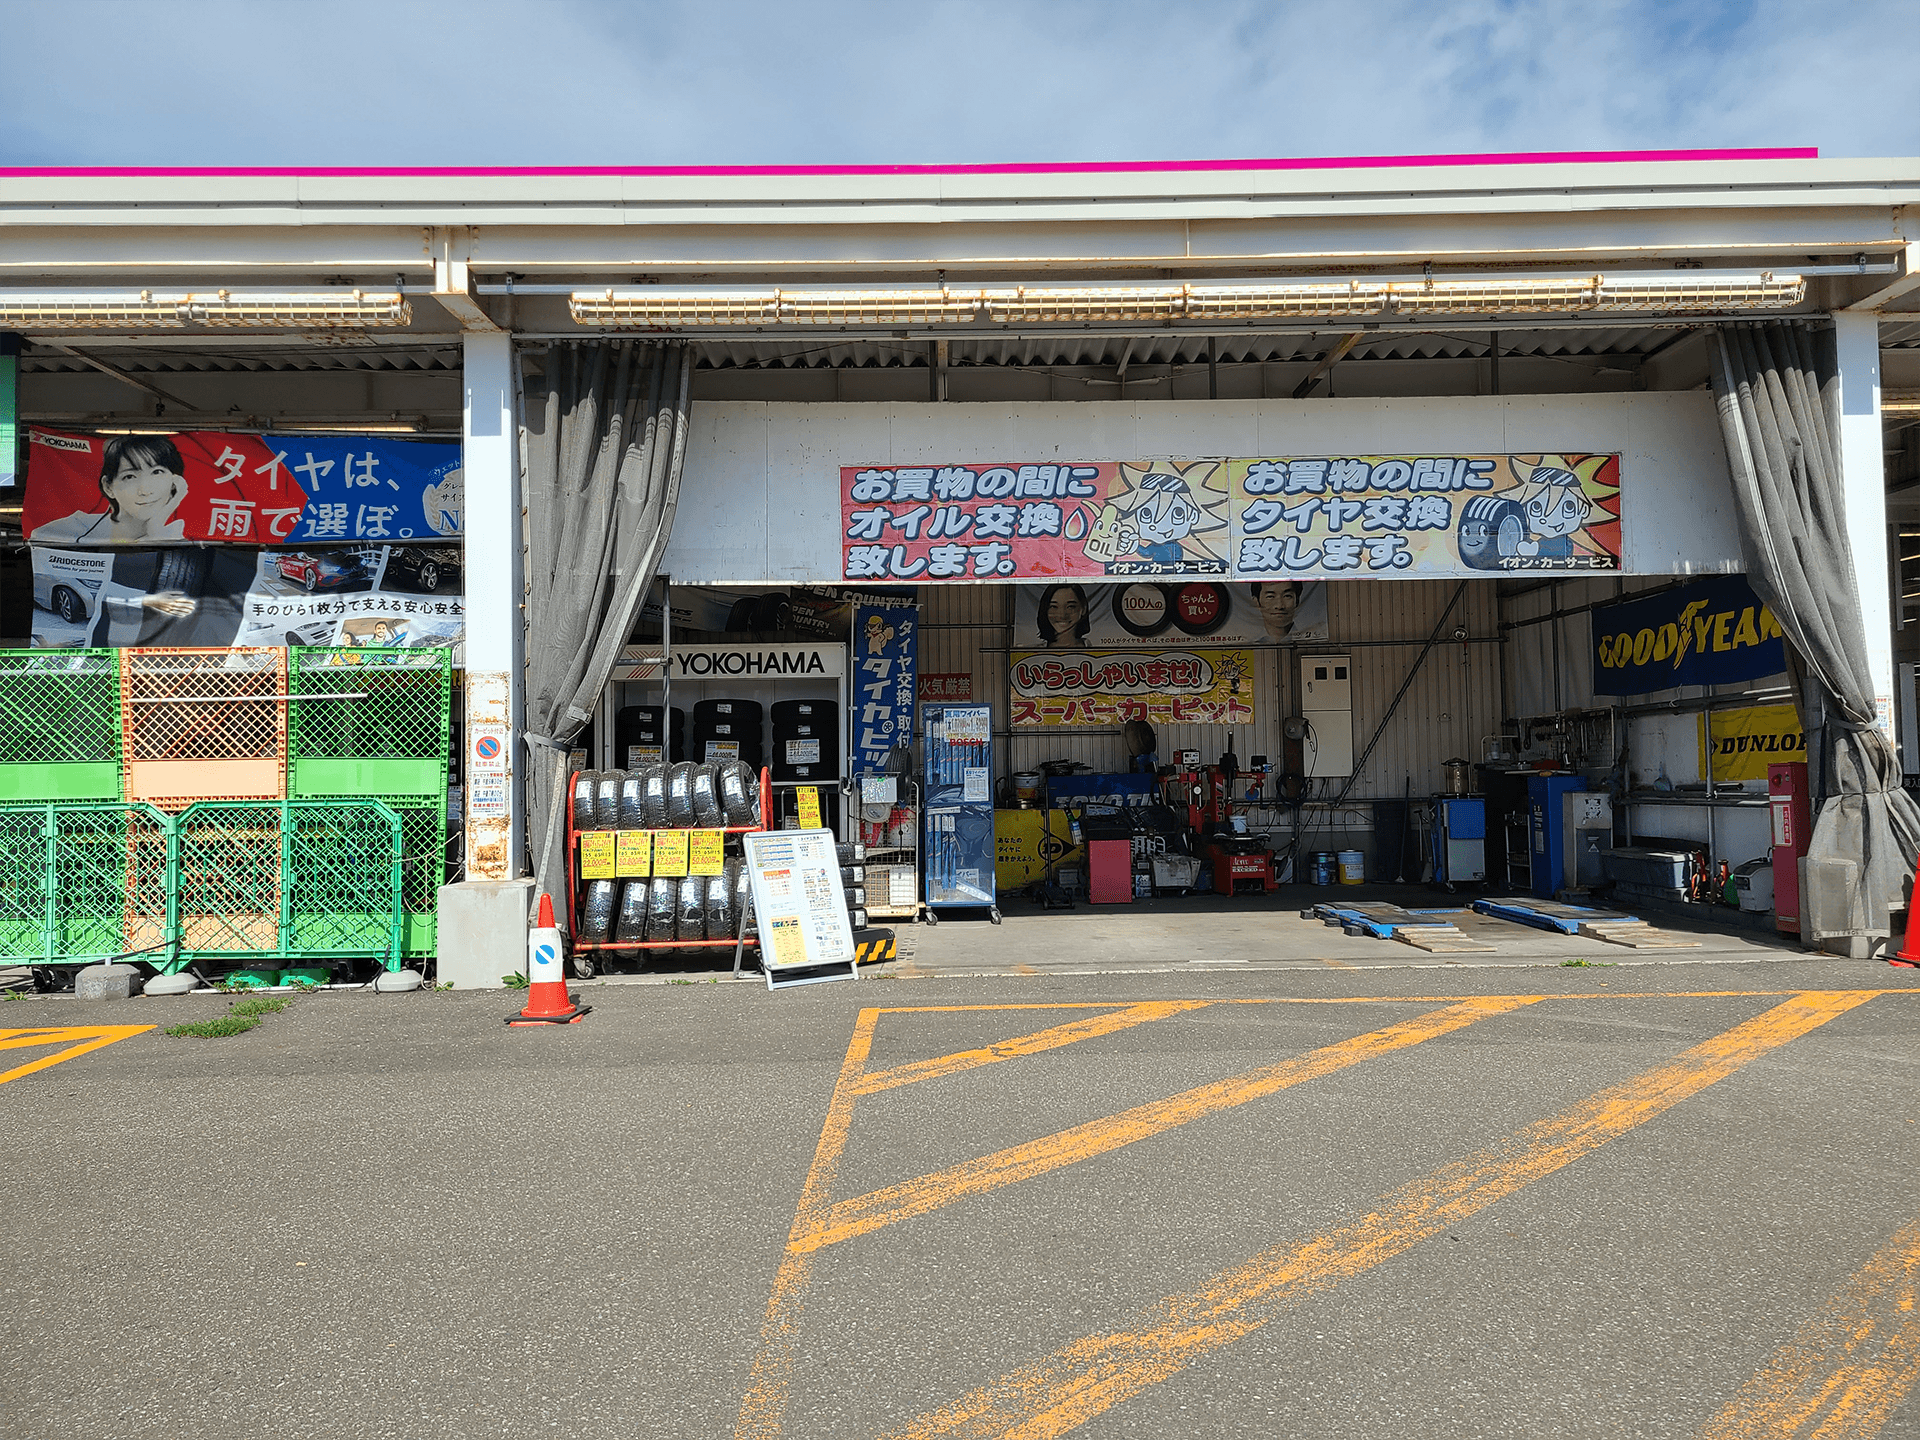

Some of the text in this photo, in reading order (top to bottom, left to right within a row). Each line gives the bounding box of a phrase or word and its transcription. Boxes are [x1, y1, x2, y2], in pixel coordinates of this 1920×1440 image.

[45, 437, 88, 450] YOKOHAMA
[214, 446, 400, 492] タイヤは、
[1243, 458, 1495, 494] お買物の間に
[850, 466, 1098, 502] お買物の間に
[207, 498, 414, 538] 雨で選ぼ。
[845, 502, 1062, 542] オイル交換
[1242, 495, 1454, 533] タイヤ交換
[1089, 539, 1113, 557] OIL
[1237, 534, 1413, 573] 致します。
[49, 555, 106, 567] BRIDGESTONE
[844, 542, 1017, 579] 致します。
[1108, 562, 1222, 574] イオン・カーサービス
[1499, 557, 1613, 569] イオン・カーサービス
[252, 598, 463, 616] 手のひら1枚分で支える安心安全
[1124, 598, 1163, 609] 100人の
[1181, 594, 1215, 604] ちゃんと
[1188, 605, 1212, 616] 買い。
[676, 652, 826, 675] YOKOHAMA
[897, 620, 913, 749] タイヤ交換・取付
[919, 678, 970, 695] 火気厳禁
[1012, 698, 1252, 723] スーパーカーピット
[950, 738, 982, 746] BOSCH
